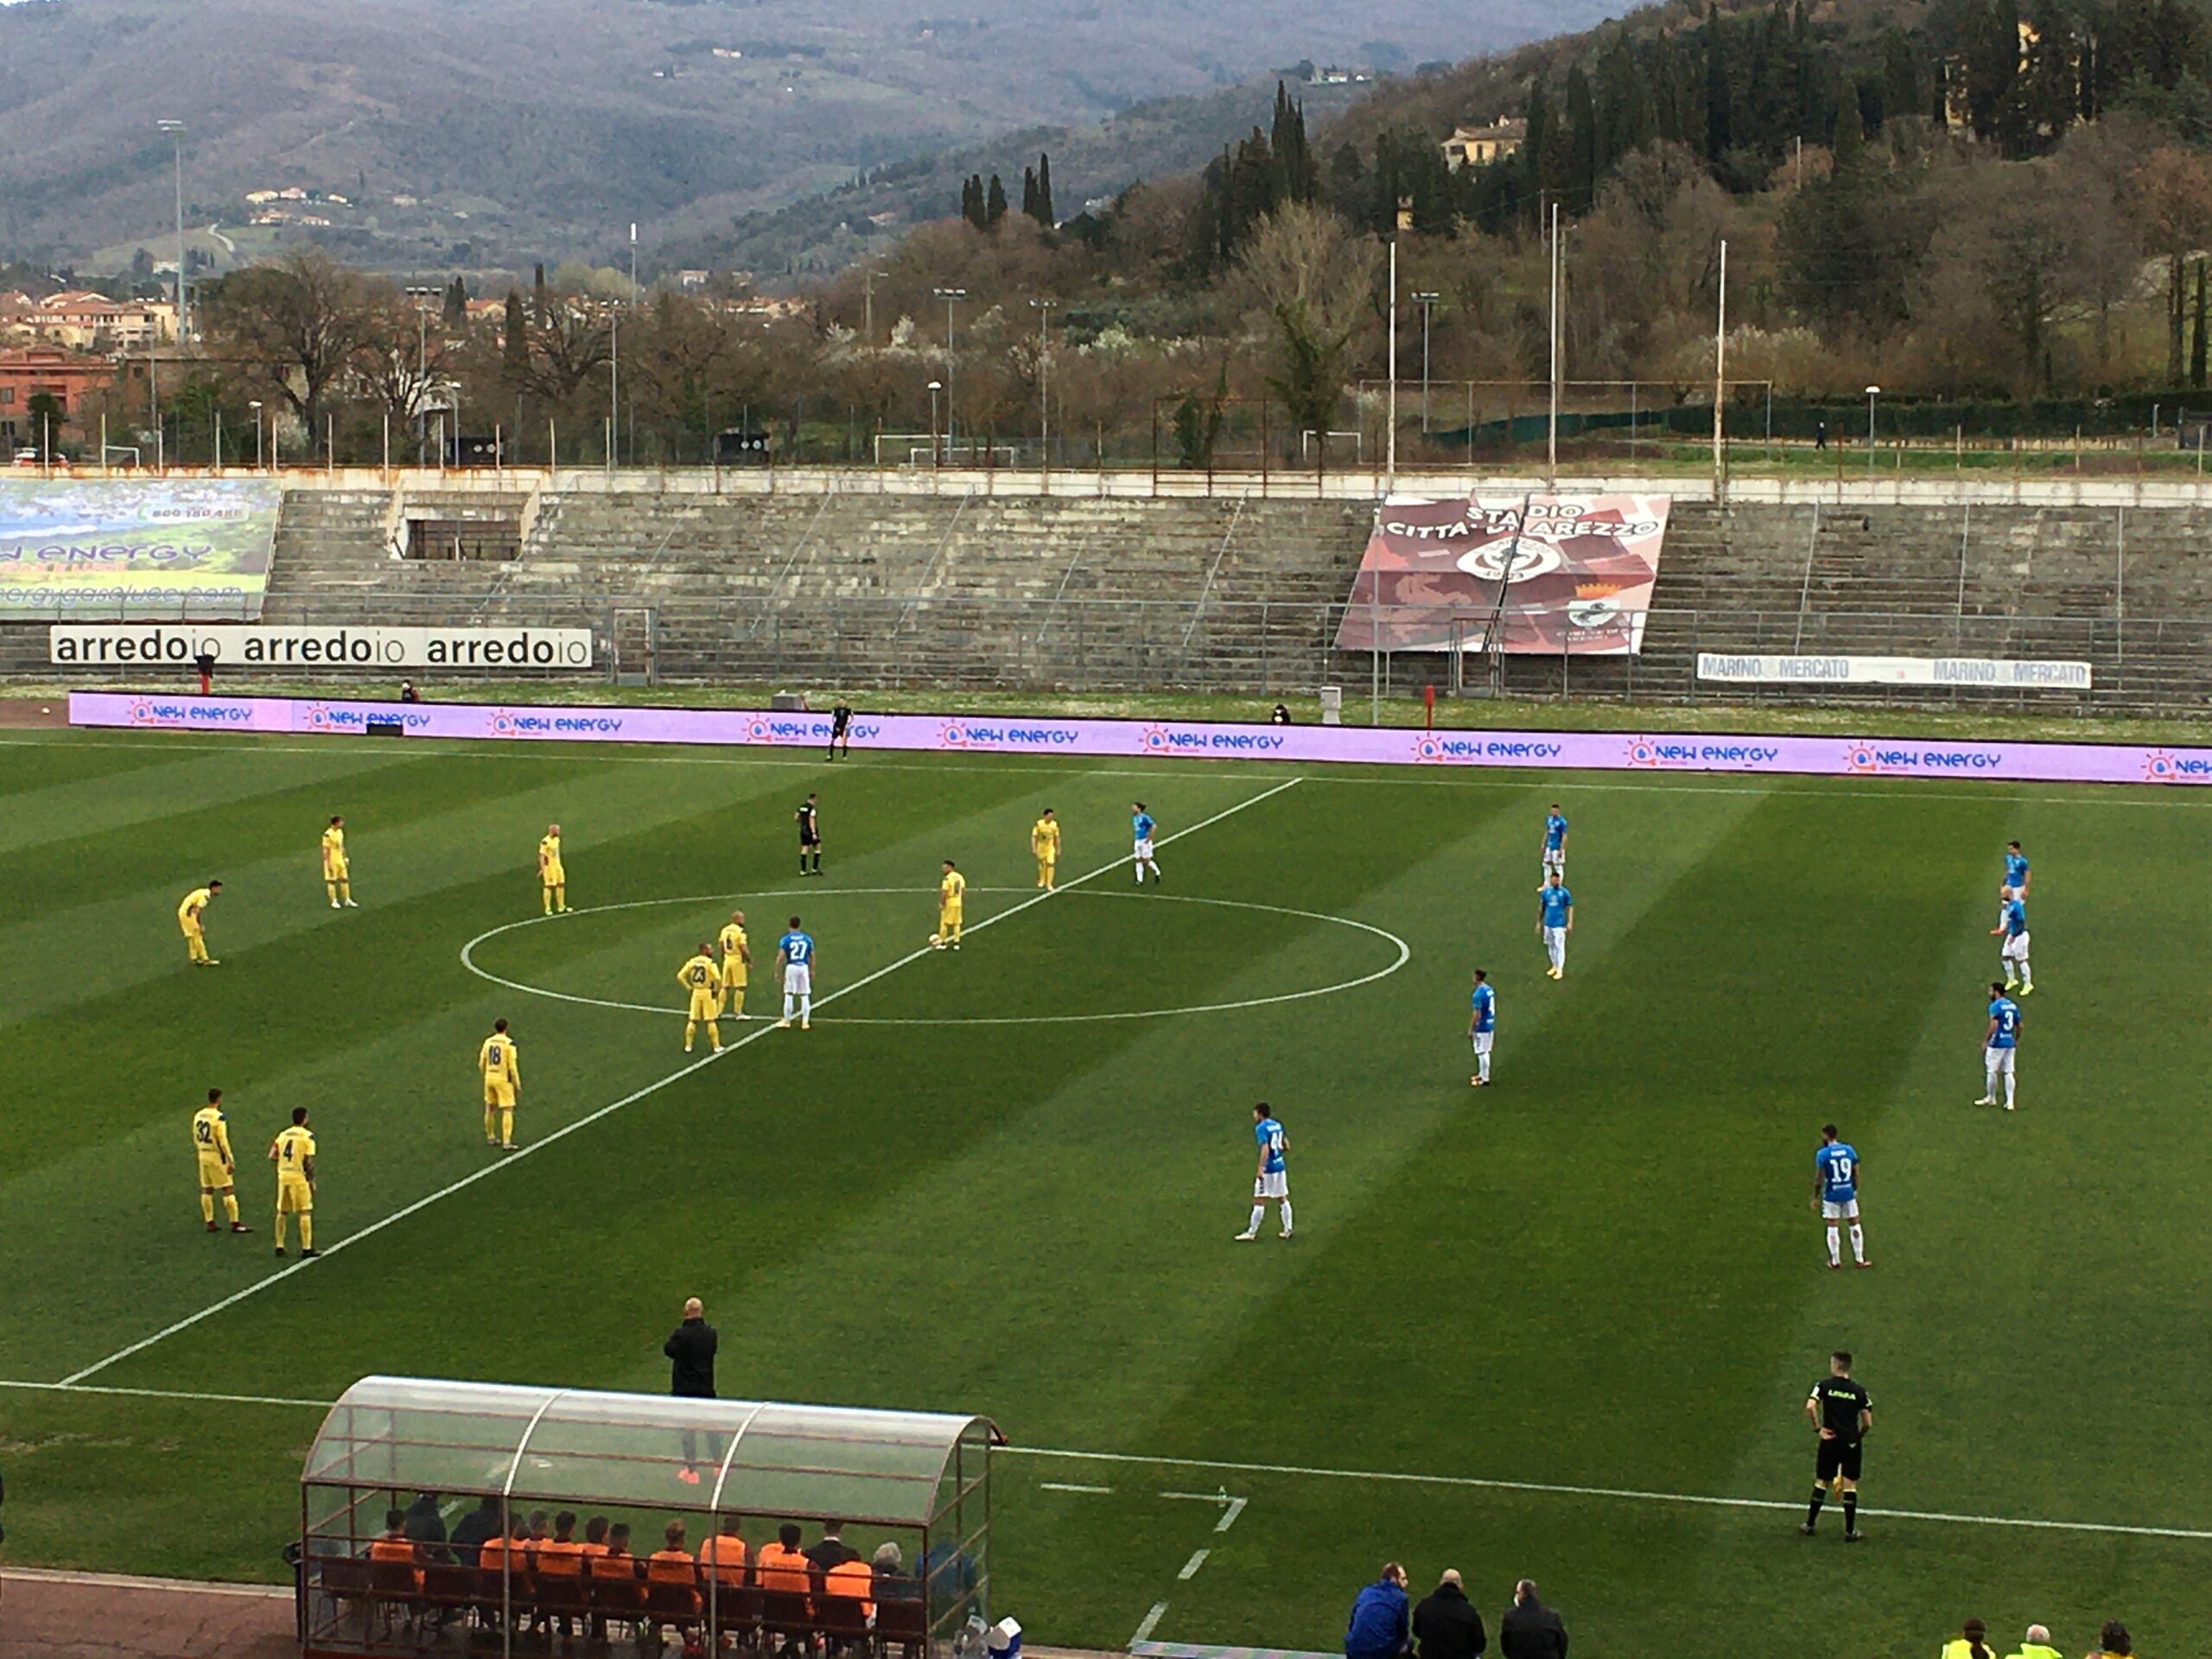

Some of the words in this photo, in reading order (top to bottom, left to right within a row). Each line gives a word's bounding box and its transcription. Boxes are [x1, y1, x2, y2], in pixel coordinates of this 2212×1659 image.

[1466, 505, 1585, 527] STADIO
[1531, 521, 1659, 536] AREZZO
[57, 628, 221, 661] arredoio
[245, 630, 404, 663] arredoio
[427, 632, 588, 664] arredoio
[1702, 657, 1762, 677] MARINO
[1779, 658, 1849, 678] MERCATO
[1933, 660, 1996, 682] MARINO
[2014, 663, 2087, 683] MERCATO
[789, 940, 807, 960] 27
[692, 965, 705, 983] 23
[2003, 1010, 2013, 1031] 3
[488, 1045, 501, 1065] 18
[196, 1119, 213, 1144] 32
[283, 1139, 293, 1162] 4
[1830, 1157, 1852, 1183] 19
